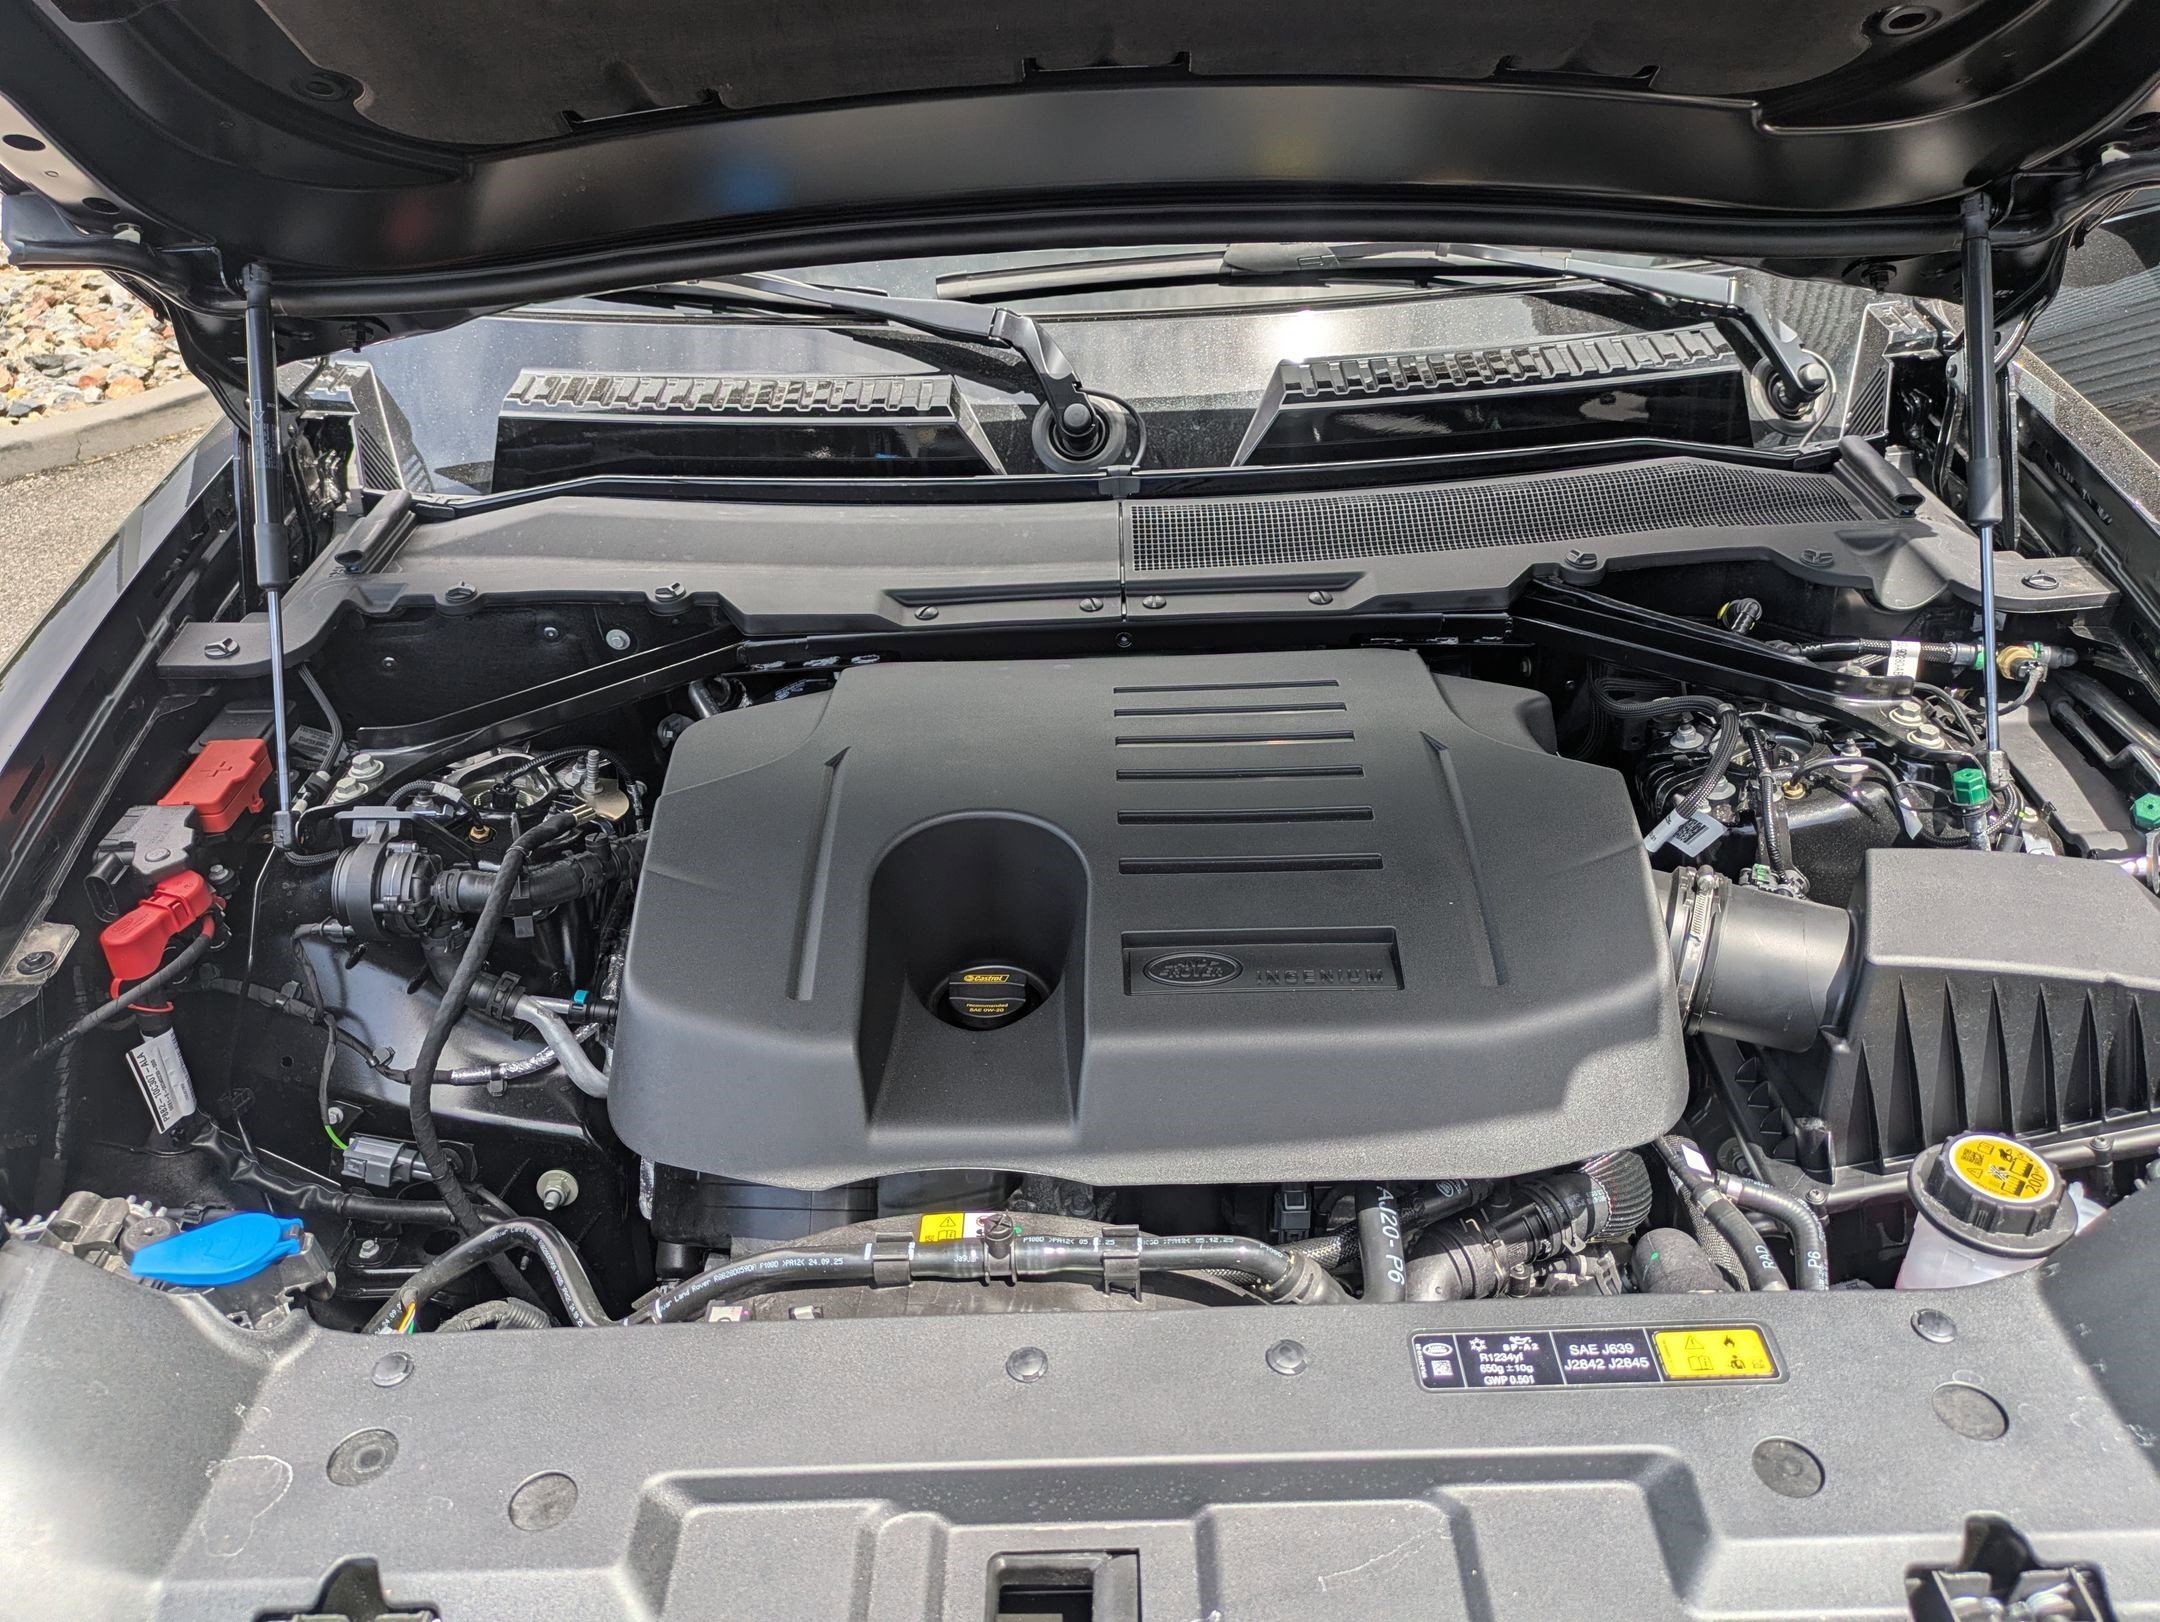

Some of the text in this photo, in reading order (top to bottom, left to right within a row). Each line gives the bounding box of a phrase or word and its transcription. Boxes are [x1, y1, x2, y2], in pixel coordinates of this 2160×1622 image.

[1256, 968, 1385, 985] INGENIUM
[2026, 1173, 2045, 1194] 200
[1755, 1245, 1777, 1269] RAD
[1807, 1250, 1822, 1269] P6
[674, 1288, 690, 1303] Land
[691, 1278, 712, 1292] Rover
[808, 1257, 844, 1267] 24.09.25
[1569, 1343, 1634, 1356] SAE J639
[1480, 1364, 1504, 1375] 650g
[1564, 1357, 1650, 1370] J2842 J2845
[1484, 1375, 1535, 1385] GWP 0.501
